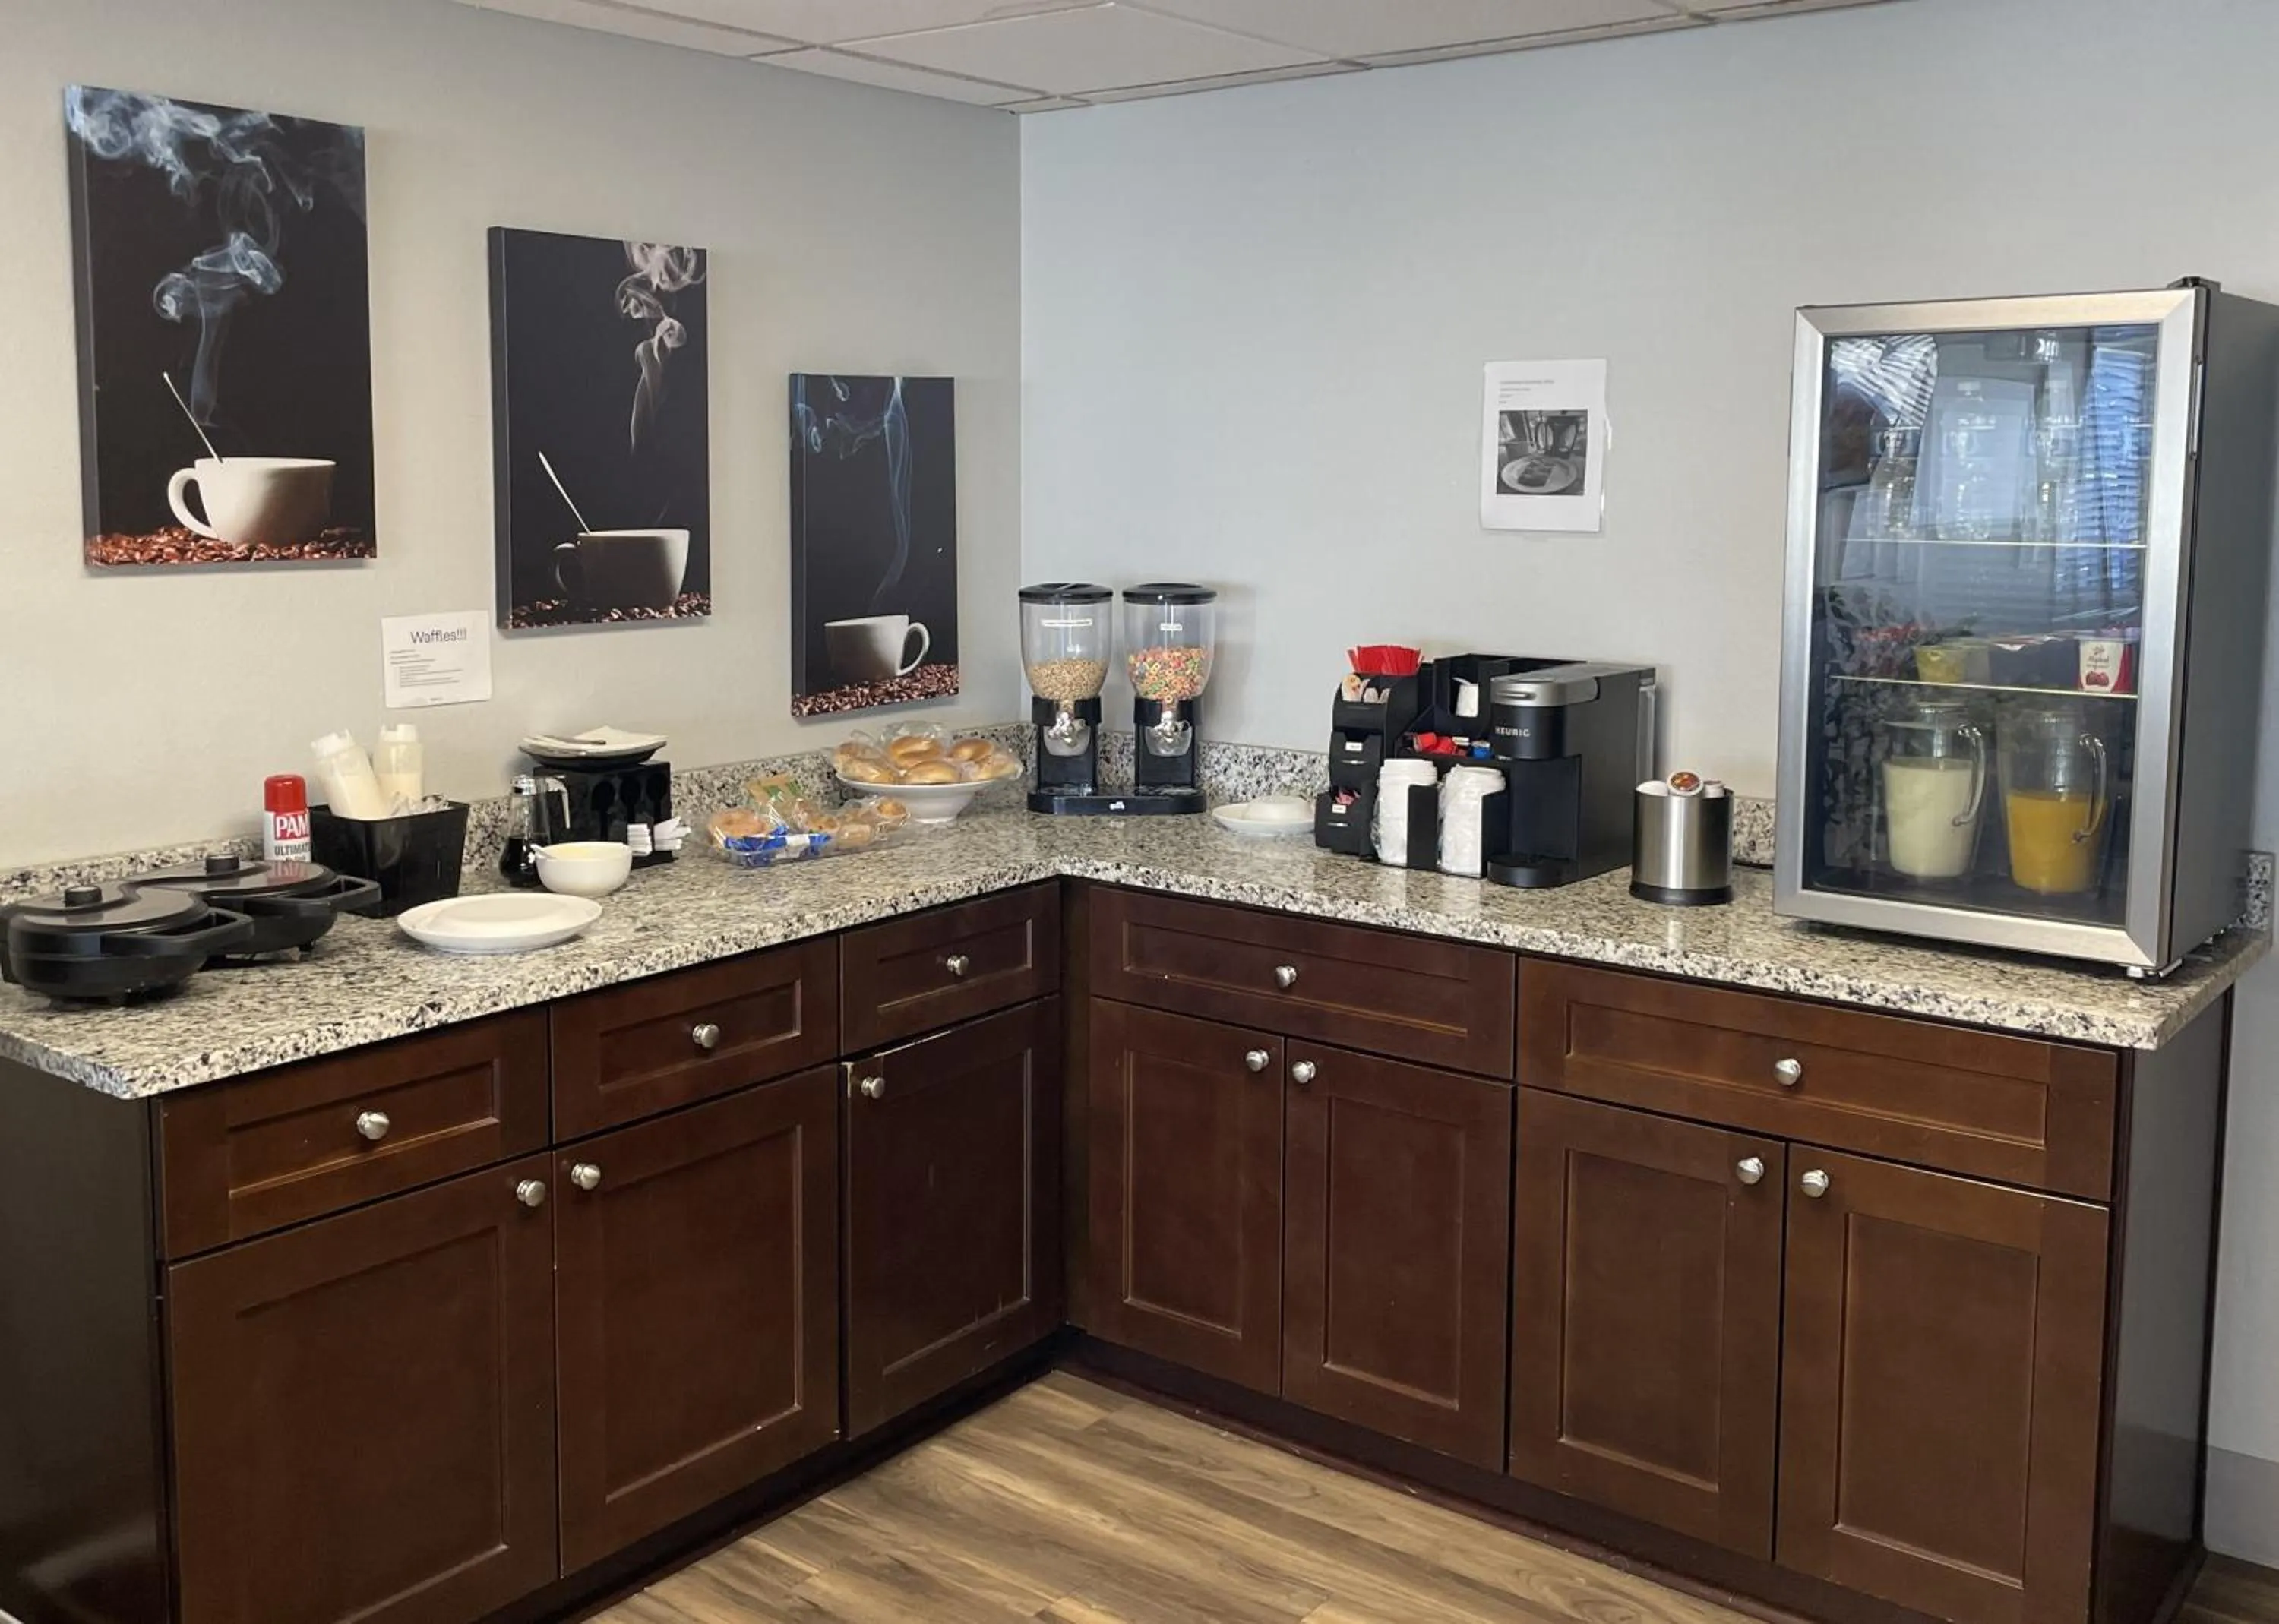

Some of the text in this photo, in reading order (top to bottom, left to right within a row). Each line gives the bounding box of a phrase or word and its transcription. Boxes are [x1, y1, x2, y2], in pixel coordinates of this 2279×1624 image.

[410, 627, 467, 644] Waffles!!!
[1495, 726, 1530, 737] KEURIG
[276, 814, 311, 839] PAM
